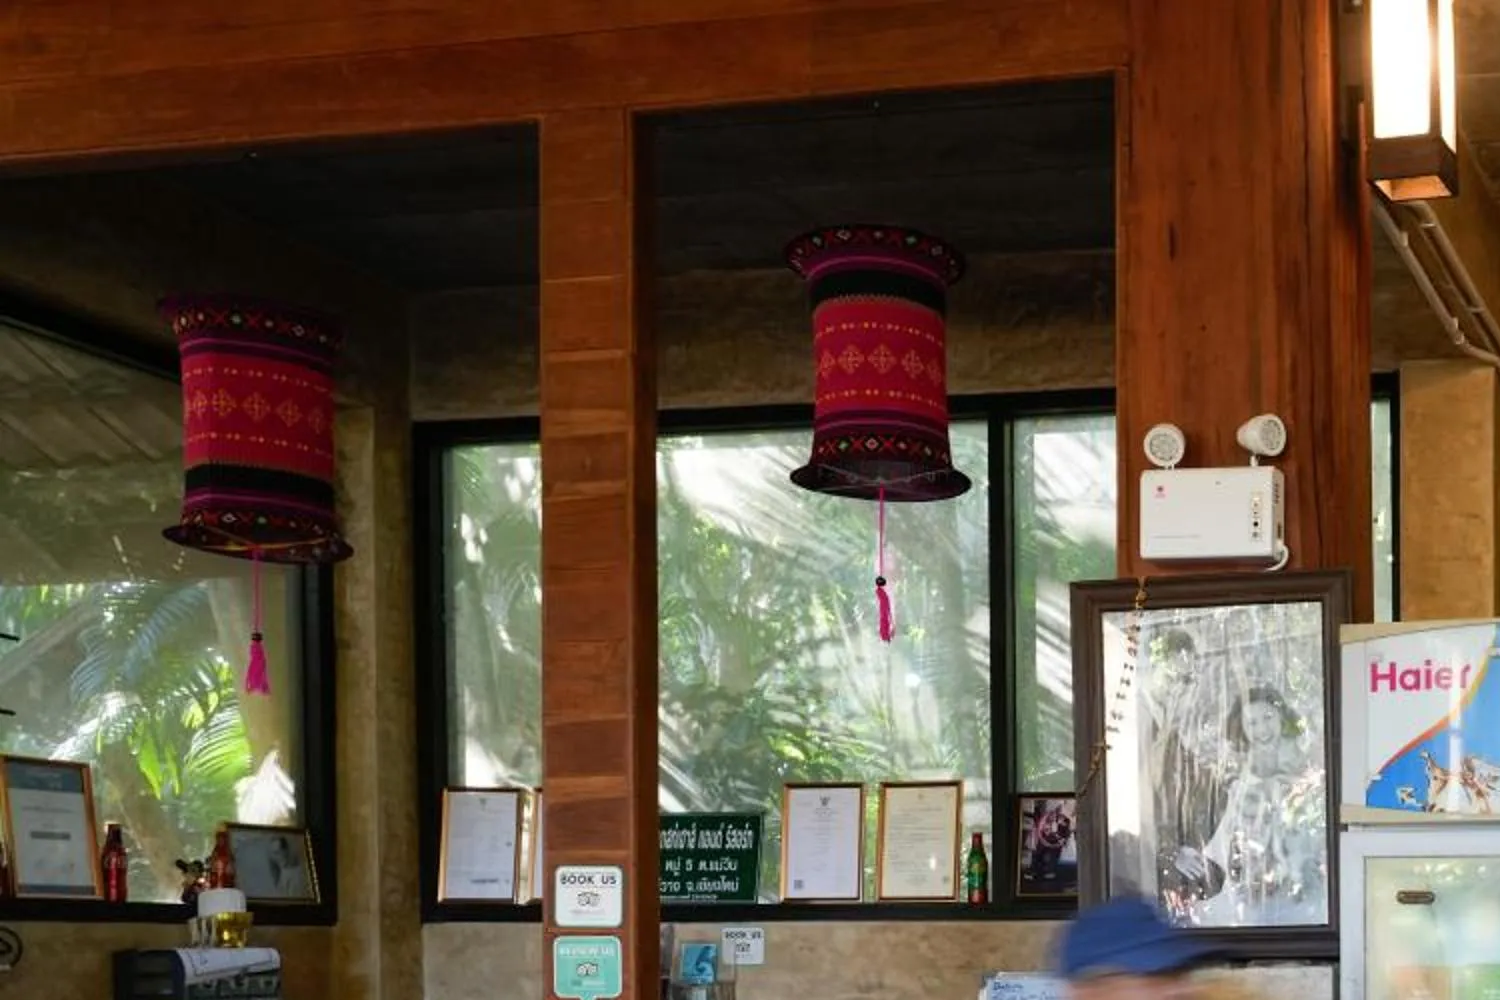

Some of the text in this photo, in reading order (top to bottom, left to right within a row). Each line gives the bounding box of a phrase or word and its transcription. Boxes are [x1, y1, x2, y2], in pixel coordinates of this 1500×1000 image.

[1370, 659, 1471, 692] Haier
[561, 875, 617, 885] BOOK US
